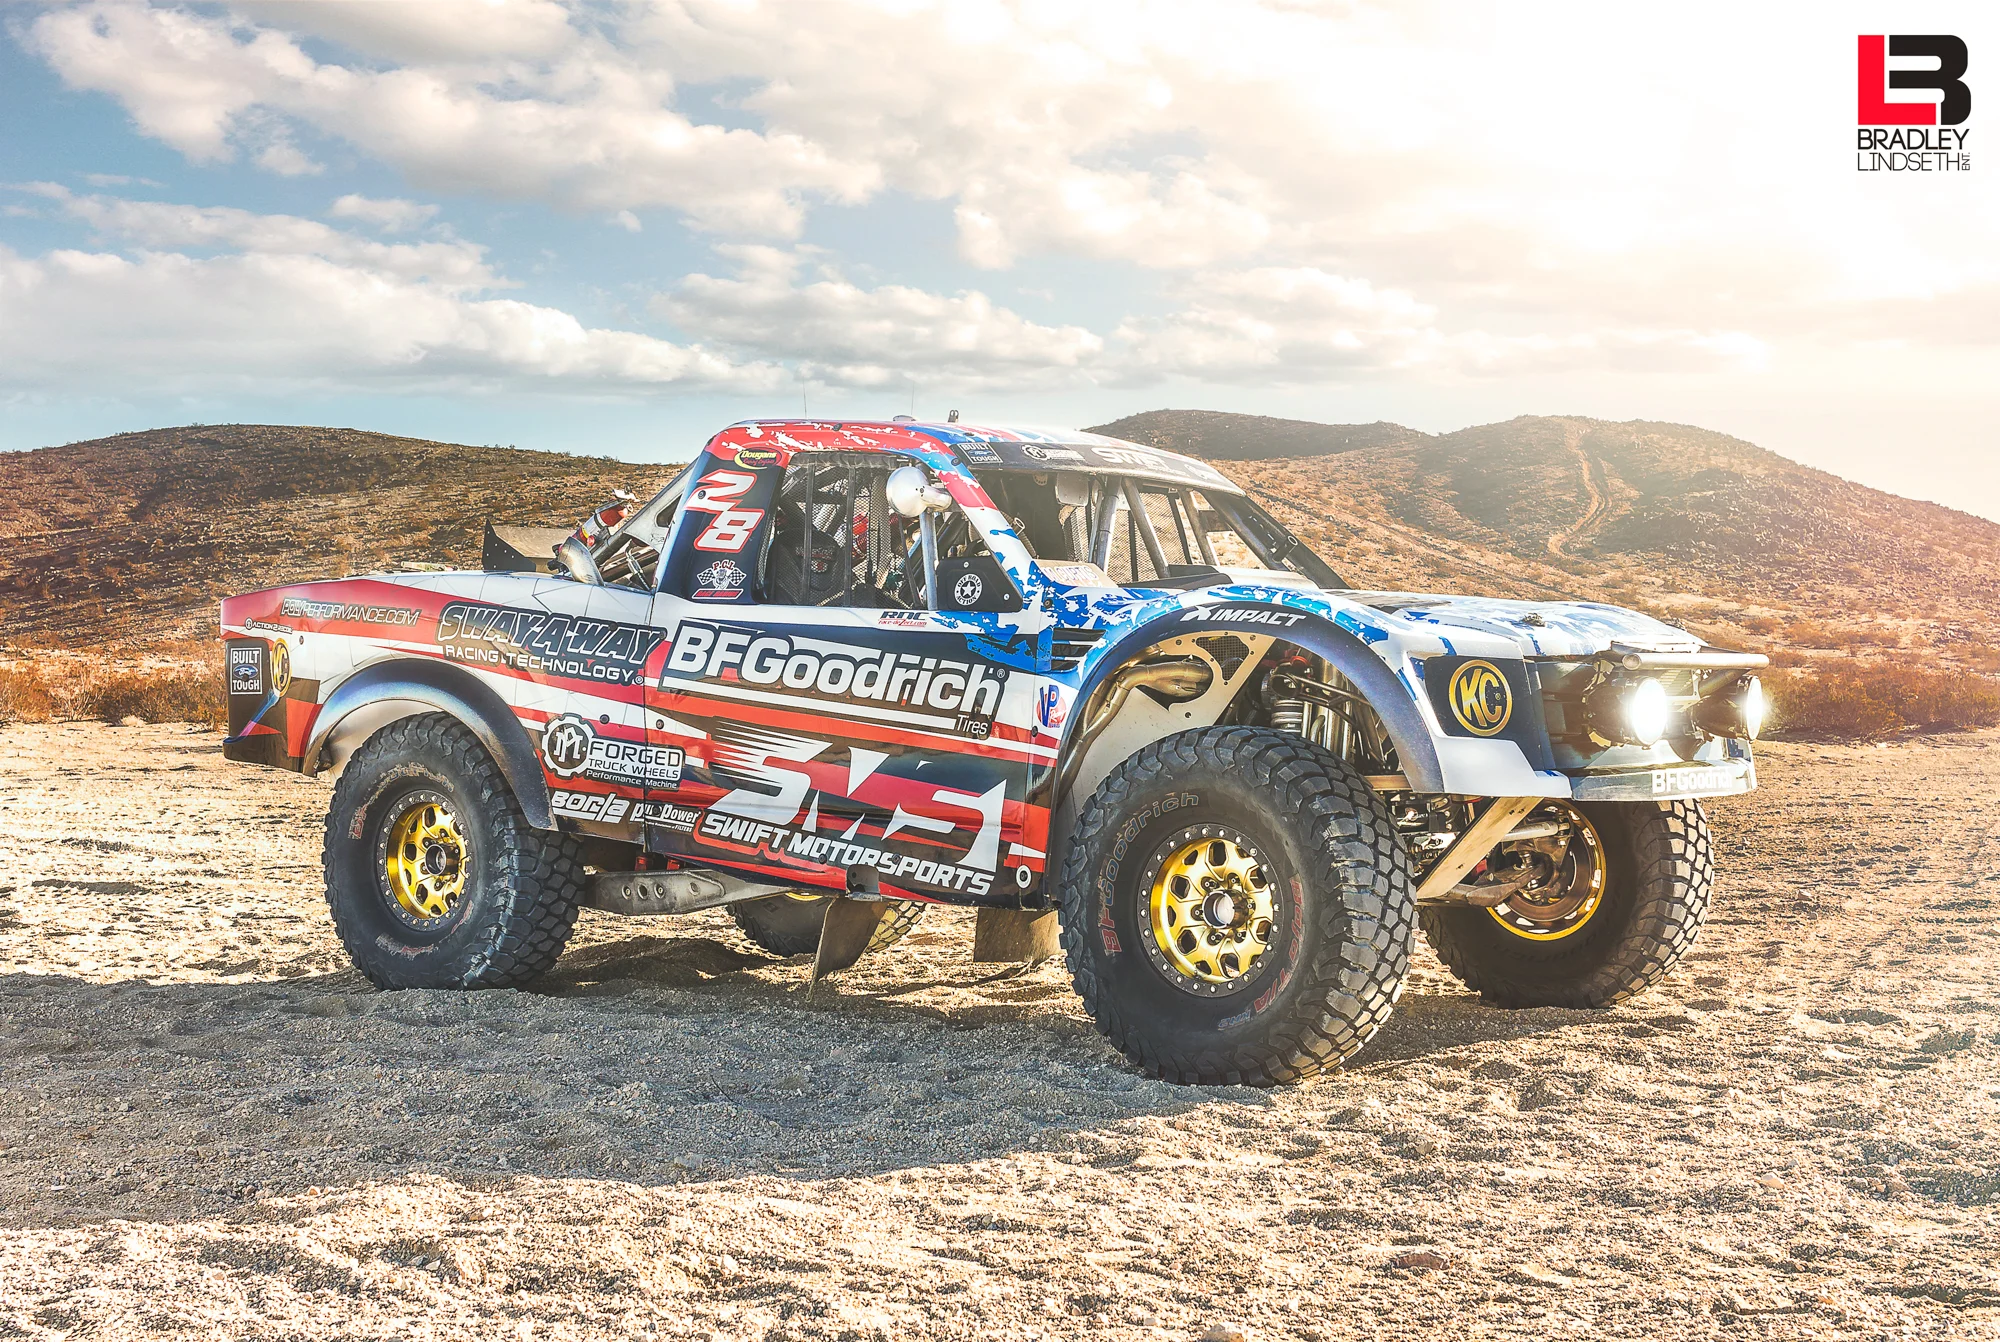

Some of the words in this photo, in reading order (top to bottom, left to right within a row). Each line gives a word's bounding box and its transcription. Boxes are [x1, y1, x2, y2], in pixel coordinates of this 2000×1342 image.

[740, 450, 777, 459] Dougans
[962, 443, 989, 451] BUILT
[684, 469, 764, 553] 28
[282, 599, 421, 626] POLYPERFORMANCE.COM
[1210, 609, 1307, 627] IMPACT
[232, 650, 260, 664] BUILT
[445, 645, 498, 662] RACING
[507, 652, 634, 682] TECHNOLOGY
[667, 624, 1002, 714] BFGoodrich
[232, 680, 260, 690] TOUGH
[1459, 668, 1501, 727] KC
[1040, 684, 1060, 728] VP
[957, 713, 988, 735] Tires
[590, 741, 680, 767] FORGED
[586, 770, 642, 785] Performance
[645, 779, 678, 789] Machine
[588, 758, 627, 773] TRUCK
[632, 765, 679, 779] WHEELS
[1651, 769, 1734, 794] BFGoodrich
[702, 814, 790, 848] SWIFT
[787, 832, 994, 895] MOTORSPORTS
